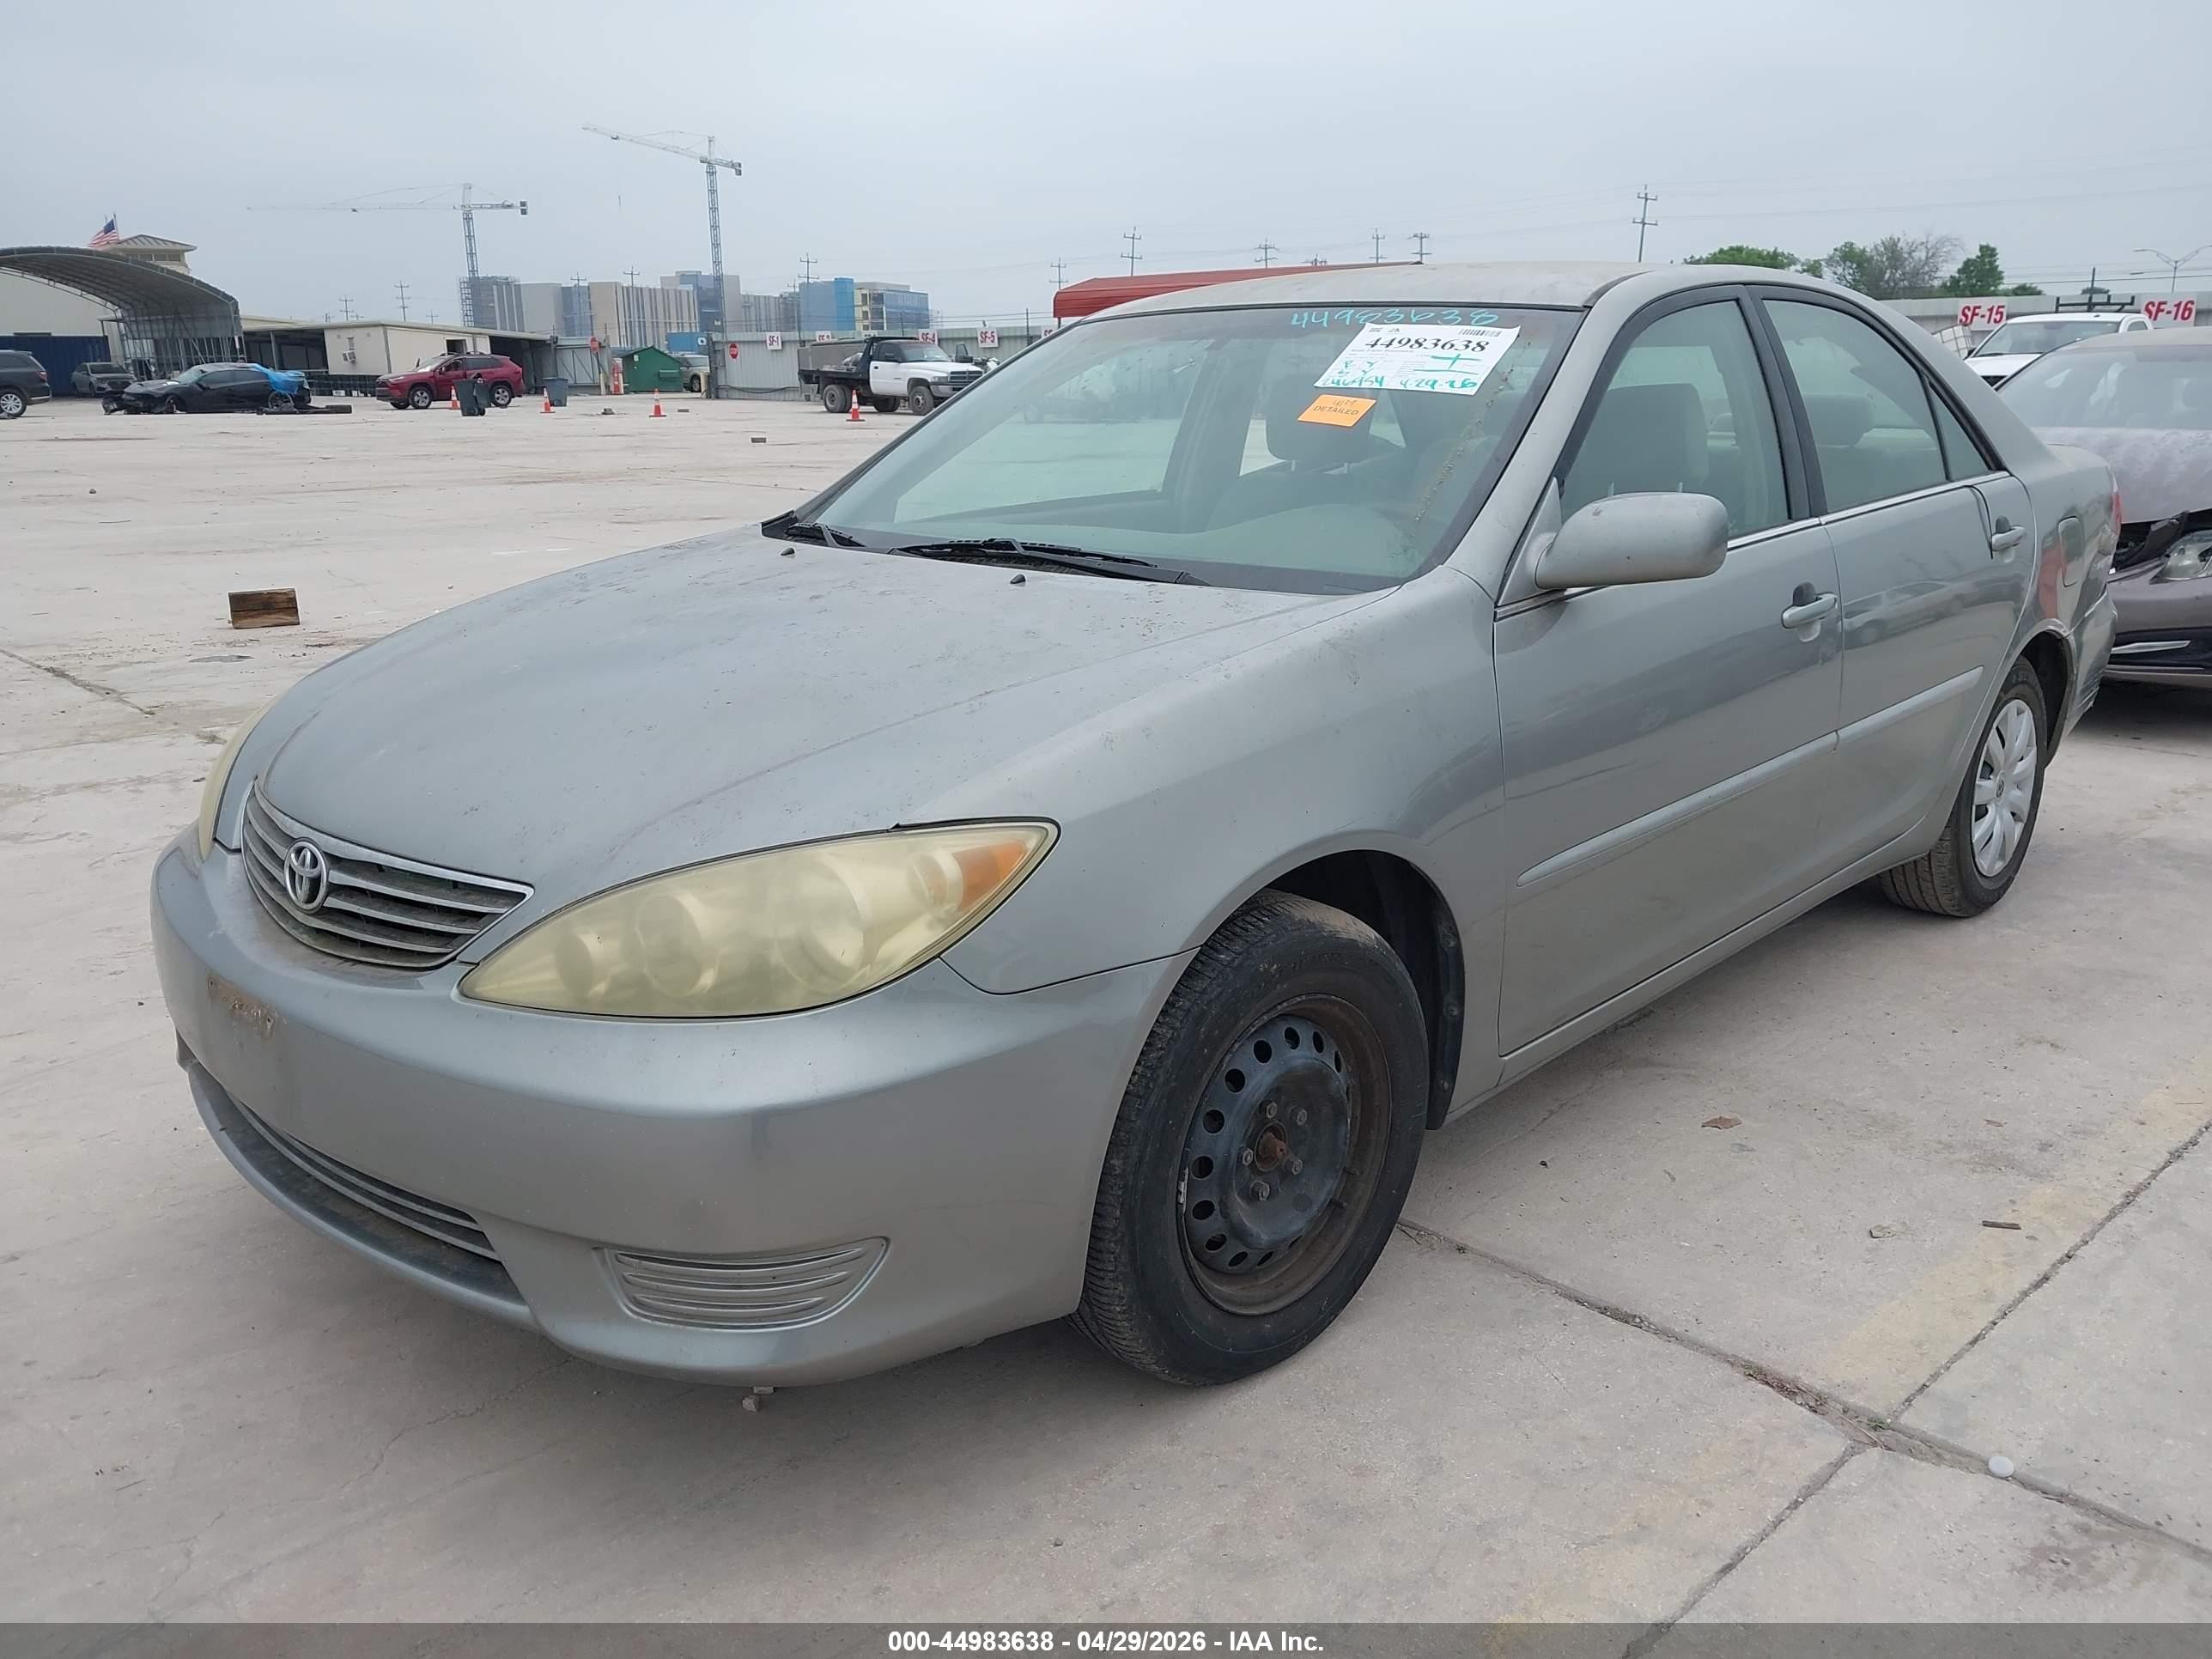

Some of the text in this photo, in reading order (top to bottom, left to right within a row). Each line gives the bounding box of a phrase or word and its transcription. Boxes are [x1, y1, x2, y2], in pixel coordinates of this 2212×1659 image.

[1291, 308, 1499, 329] 44983638
[1960, 305, 2006, 326] SF-15
[2144, 300, 2195, 321] SF-16
[921, 332, 936, 343] SF-4
[980, 331, 995, 343] SF-5
[1365, 337, 1490, 353] 44983638
[1313, 405, 1359, 416] DETAILED
